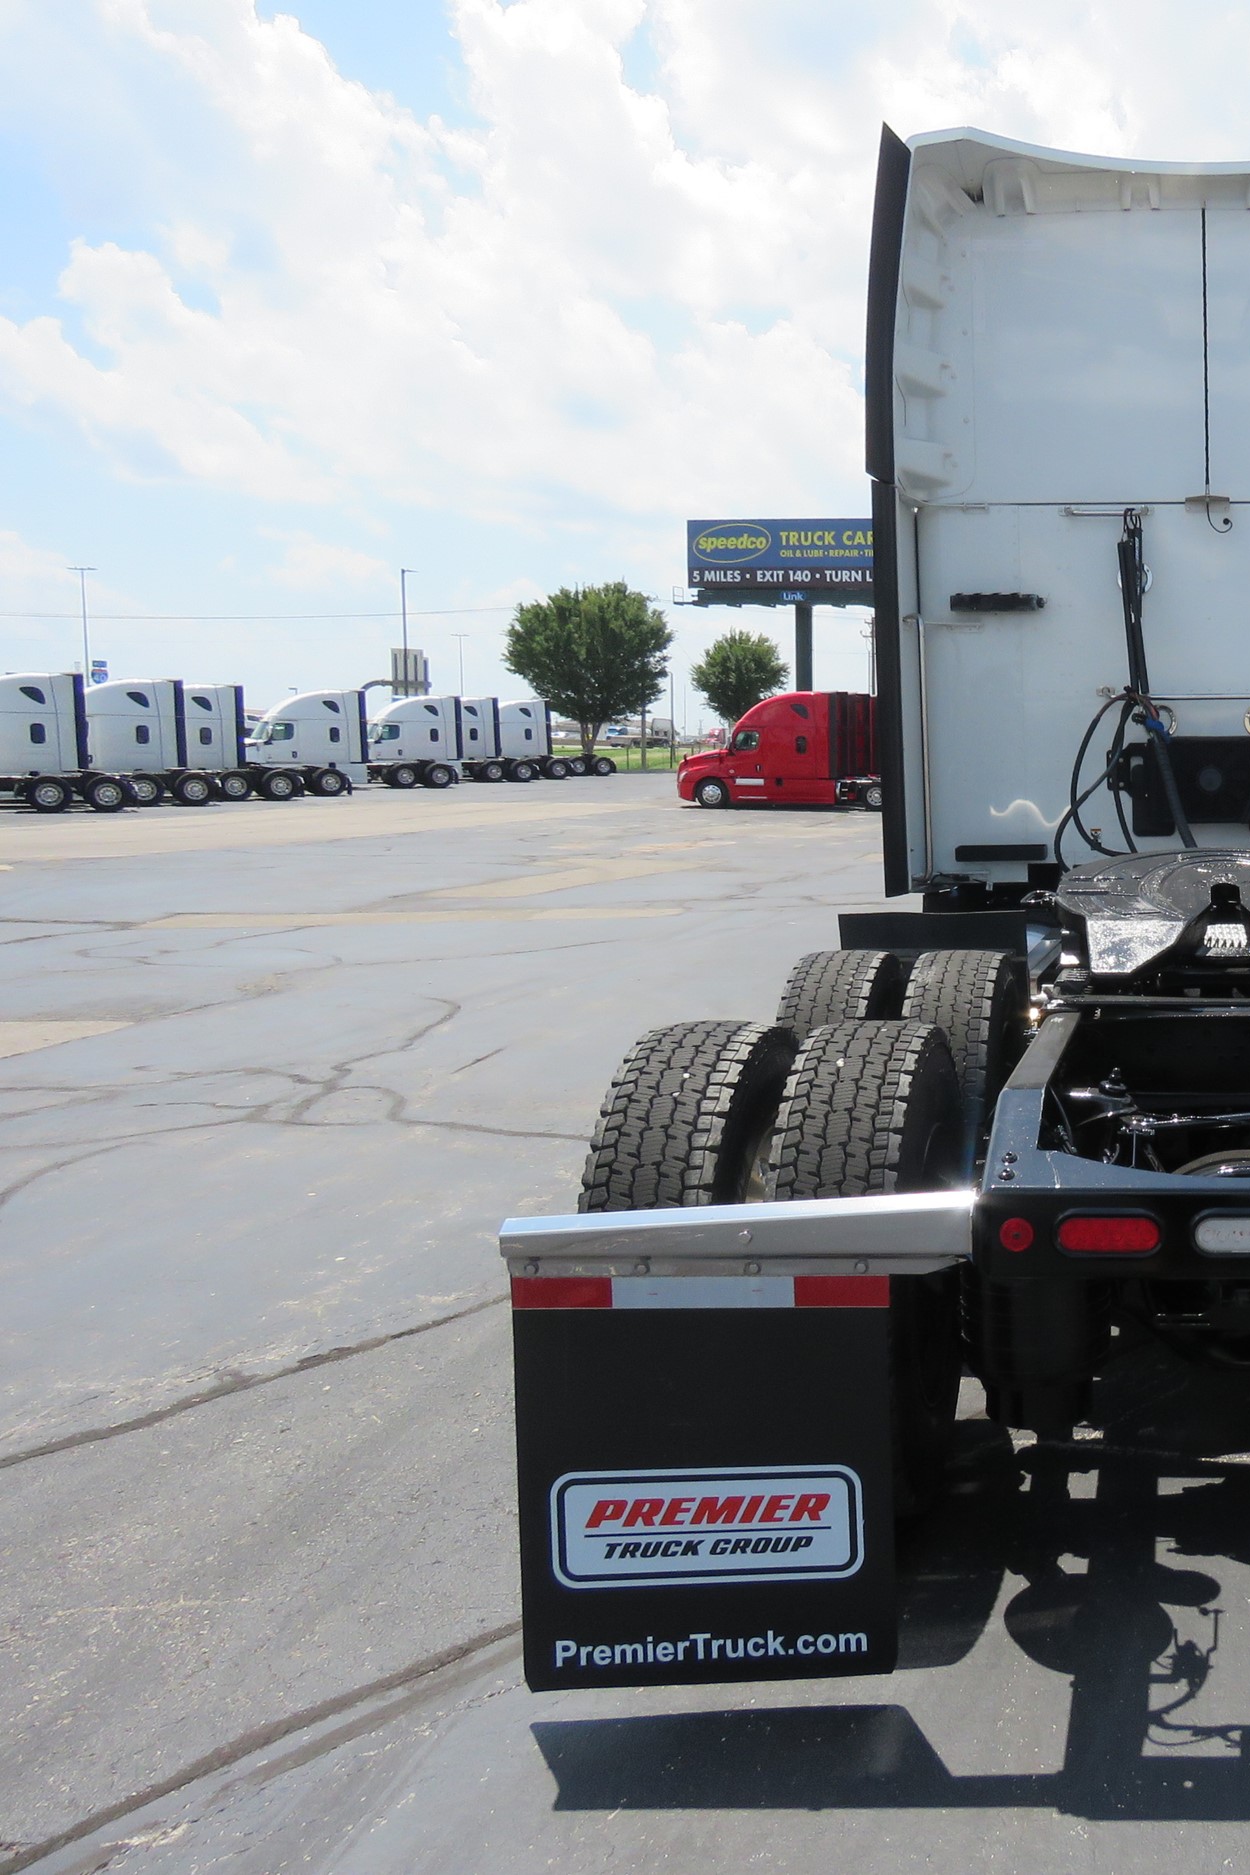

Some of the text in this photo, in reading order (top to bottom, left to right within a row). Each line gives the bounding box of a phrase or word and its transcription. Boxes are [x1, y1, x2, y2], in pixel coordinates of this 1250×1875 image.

[698, 533, 767, 552] speedco
[779, 531, 836, 546] TRUCK
[780, 549, 794, 558] OIL
[803, 549, 824, 558] LUBE
[829, 549, 859, 558] REPAIR
[692, 570, 700, 582] 5
[703, 570, 741, 582] MILES
[756, 570, 784, 582] EXIT
[788, 570, 811, 582] 140
[824, 570, 862, 582] TURN
[584, 1492, 832, 1529] PREMIER
[604, 1535, 814, 1560] TRUCK GROUP
[554, 1629, 869, 1668] PremierTruck.com
